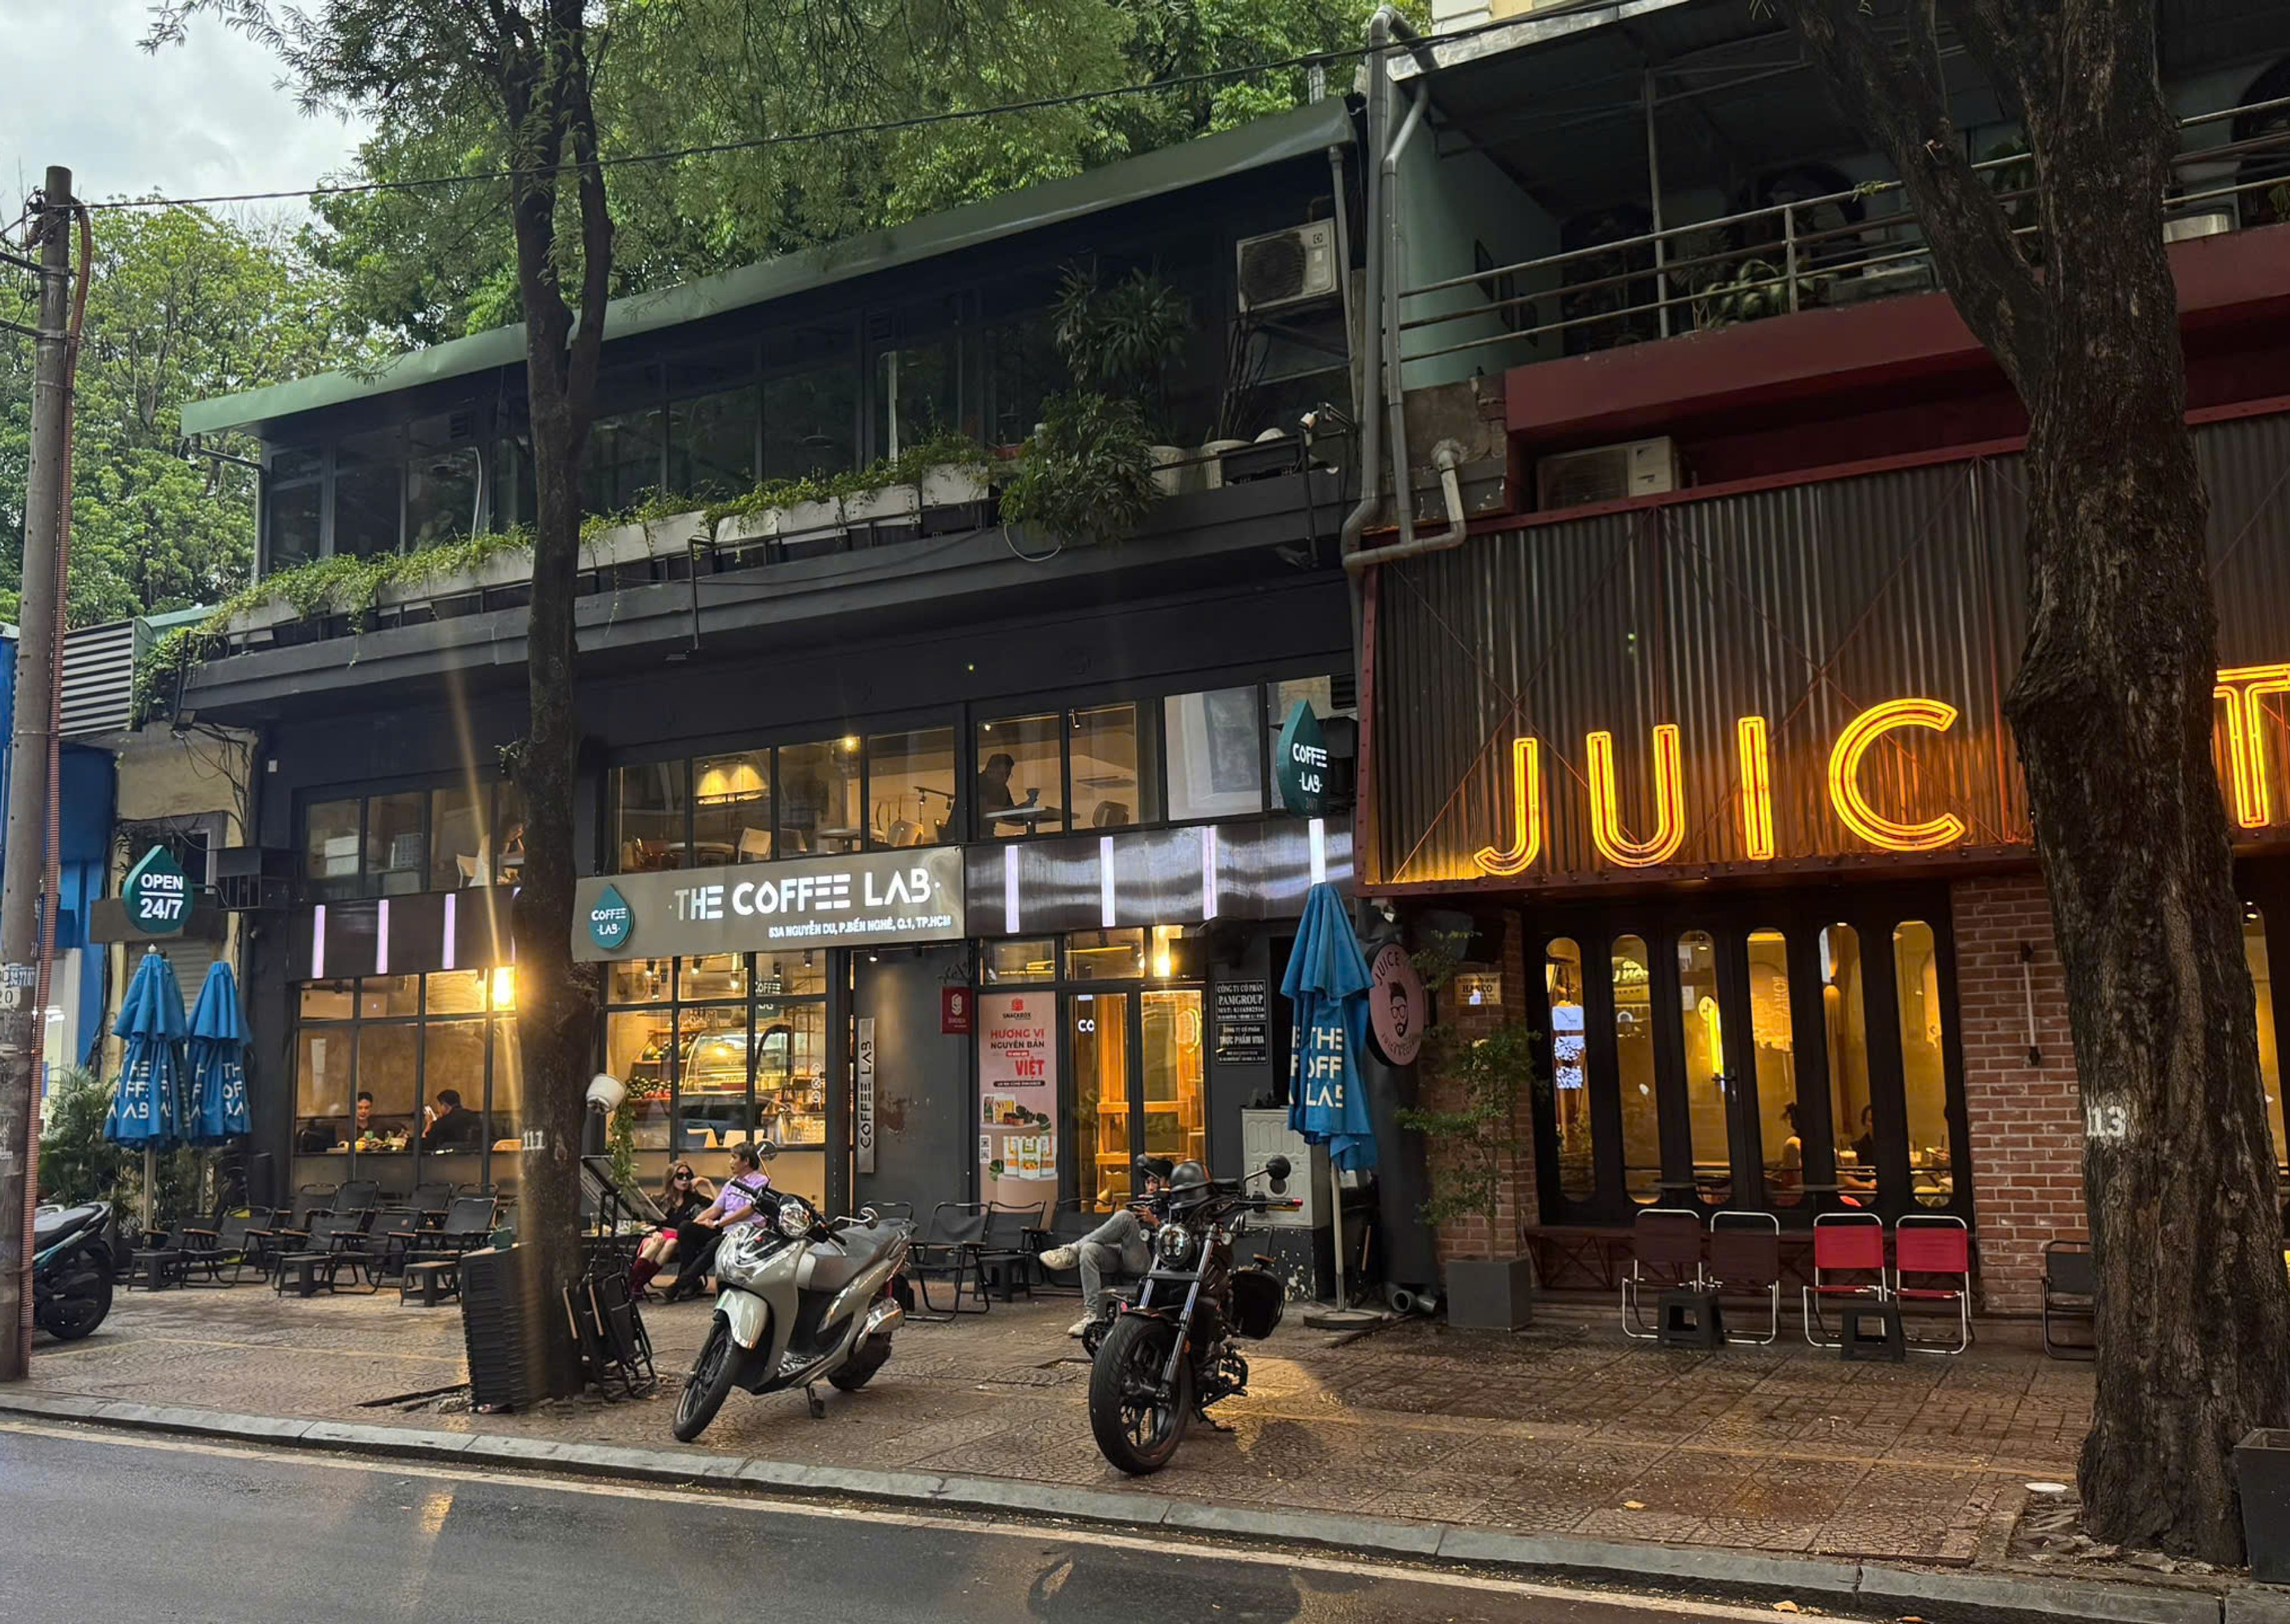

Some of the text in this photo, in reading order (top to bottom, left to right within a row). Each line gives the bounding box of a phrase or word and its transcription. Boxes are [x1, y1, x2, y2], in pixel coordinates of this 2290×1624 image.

[1292, 743, 1327, 768] COFFEE
[1301, 771, 1320, 794] LAB
[1473, 696, 1966, 876] JUIC
[141, 873, 183, 890] OPEN
[674, 867, 932, 921] THE COFFEE LAB
[140, 898, 184, 919] 24/7
[591, 907, 627, 921] COFFEE
[599, 923, 618, 935] LAB
[822, 922, 838, 935] DU,
[915, 915, 951, 928] TP.HCM
[1375, 952, 1400, 986] JUICE
[755, 981, 781, 995] OFFEE
[1218, 994, 1264, 1006] PAMGROUP
[861, 1040, 872, 1148] COFFEE LAB
